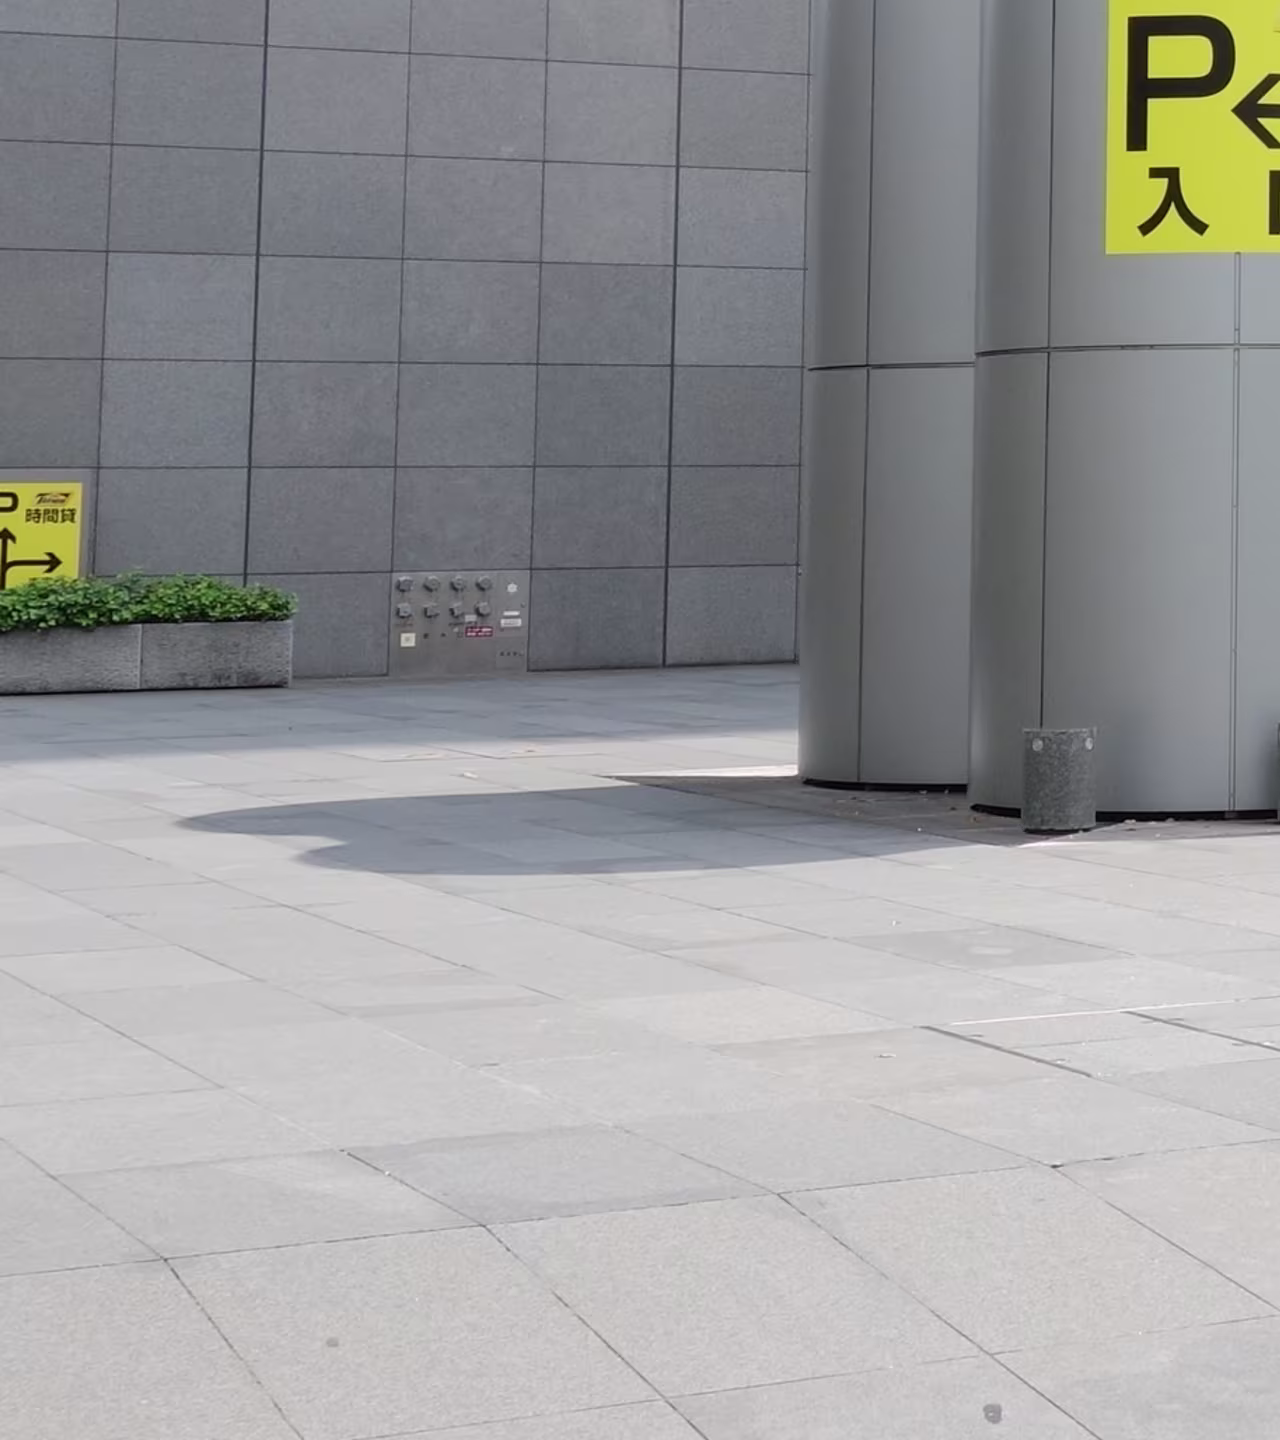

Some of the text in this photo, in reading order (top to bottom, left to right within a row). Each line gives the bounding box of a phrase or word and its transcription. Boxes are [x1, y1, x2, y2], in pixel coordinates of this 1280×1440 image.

[1126, 15, 1236, 152] P
[25, 508, 77, 524] 時間貸
